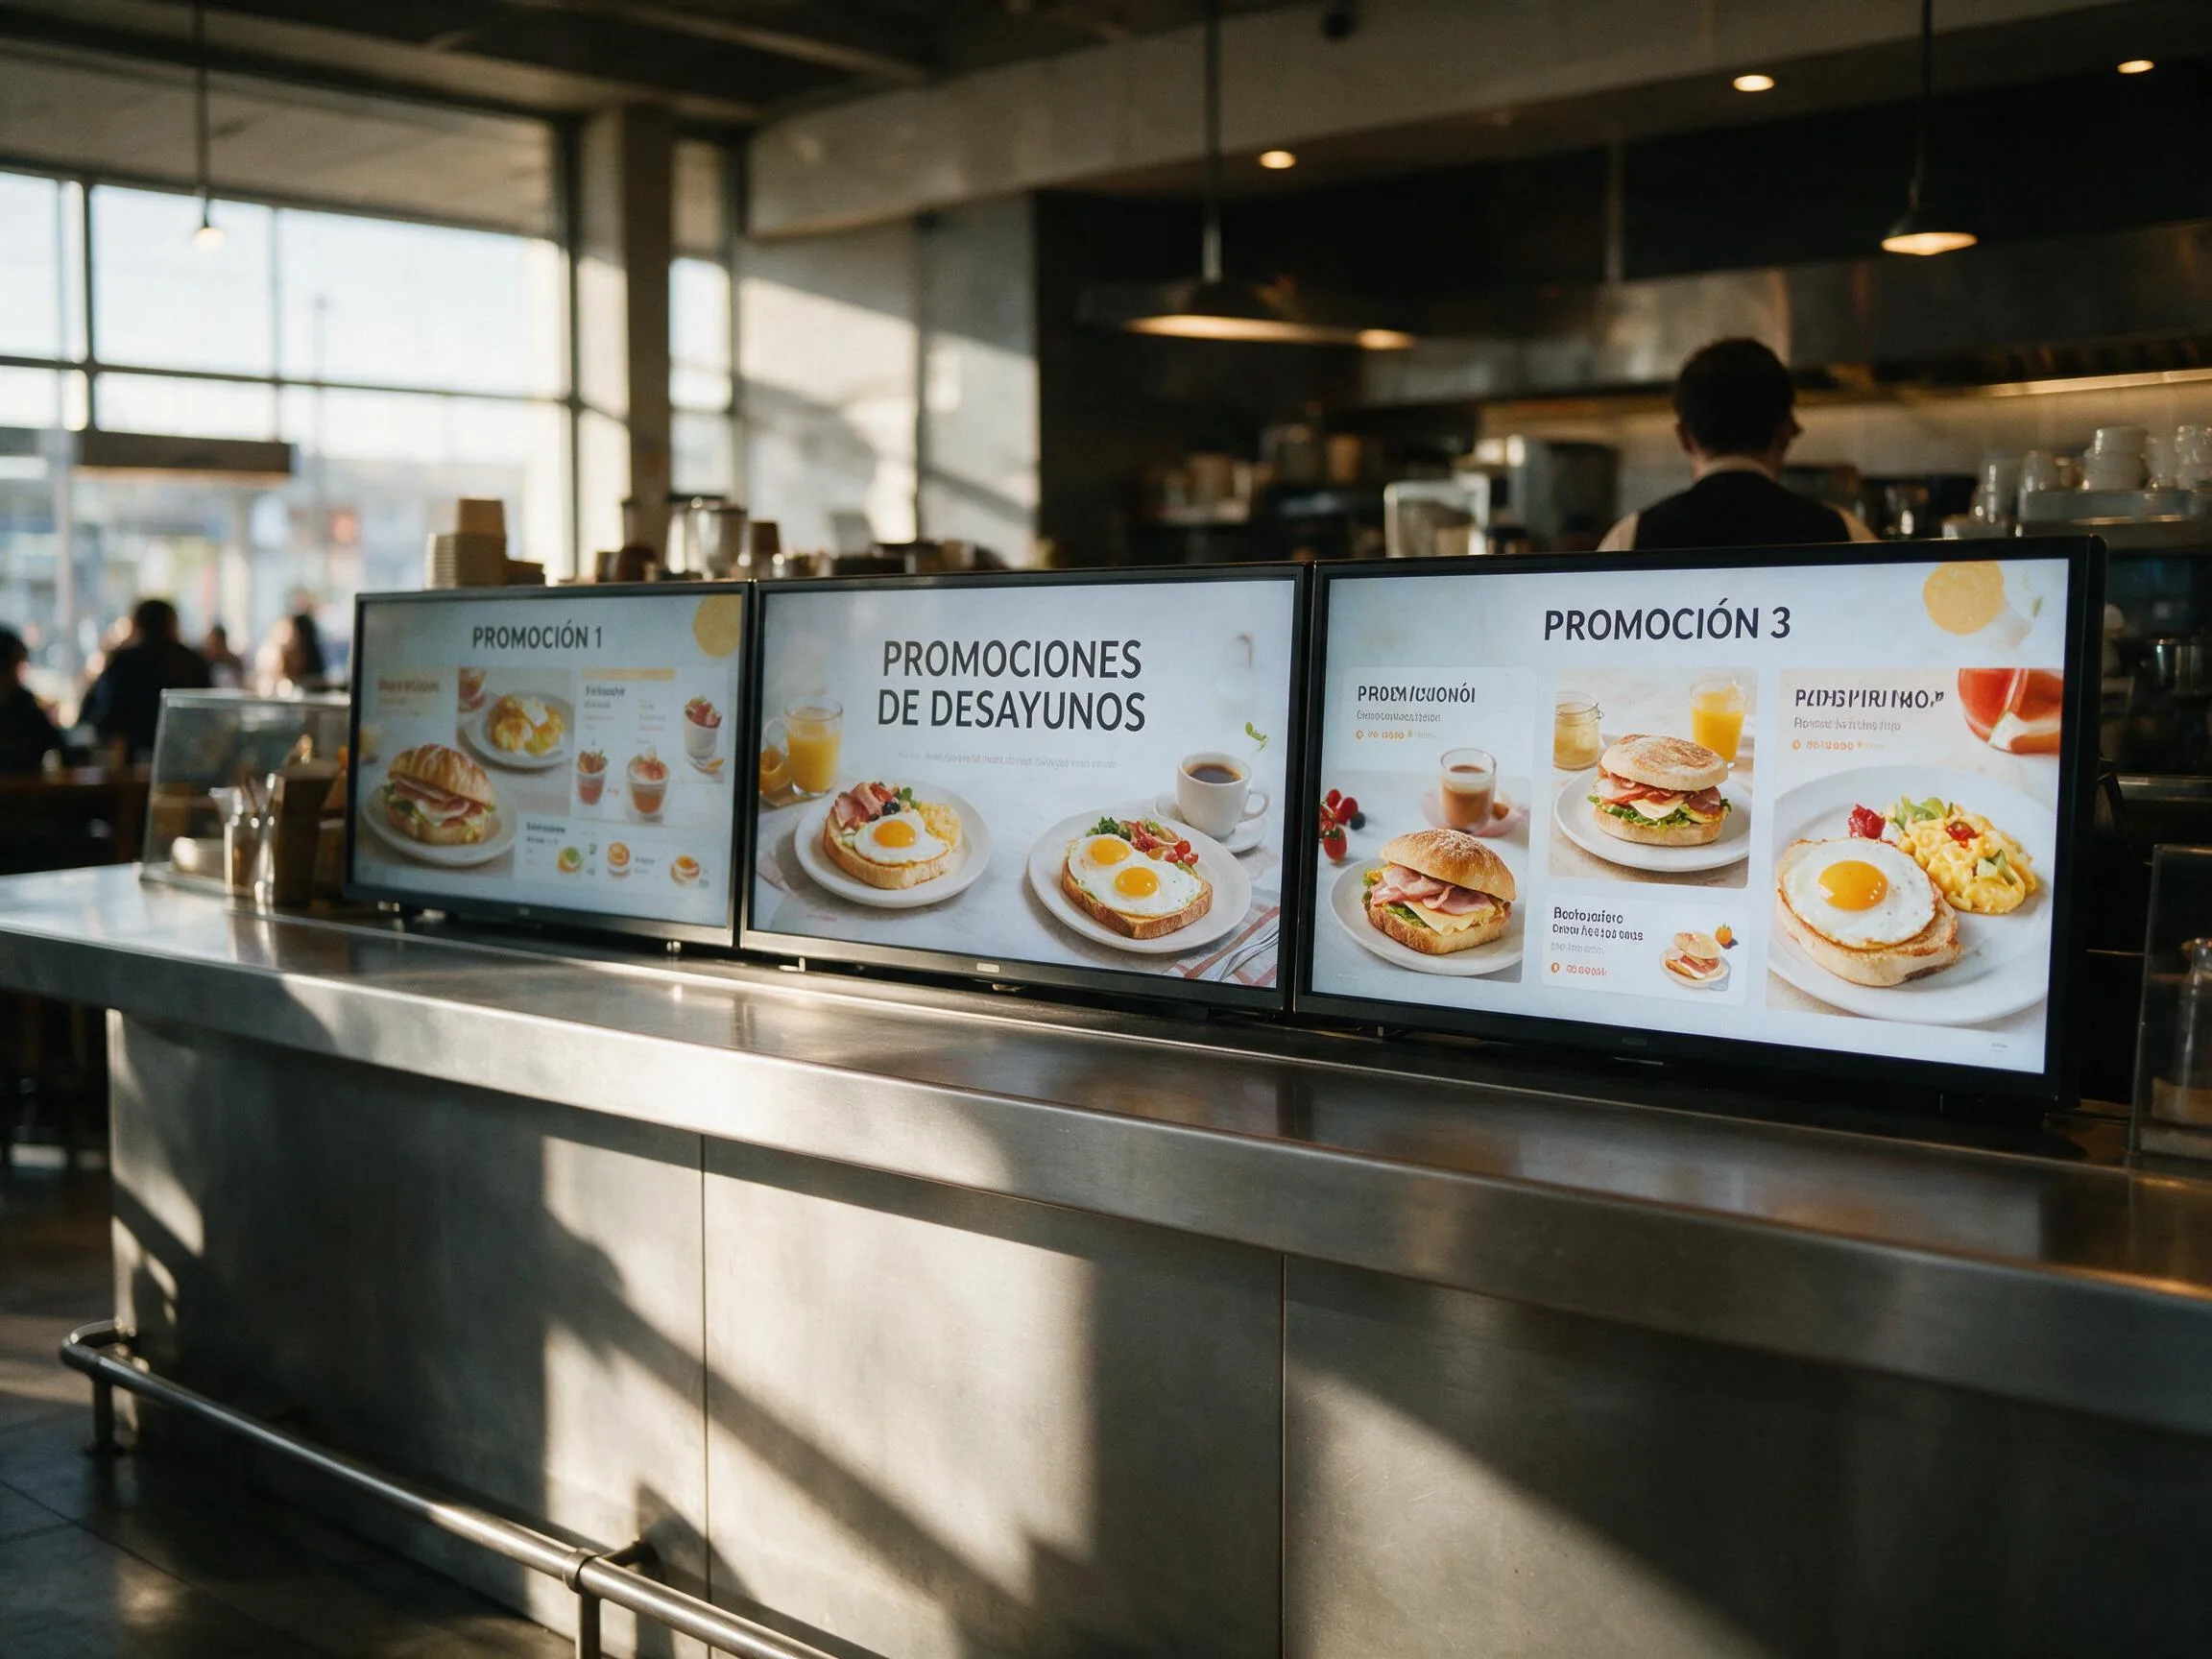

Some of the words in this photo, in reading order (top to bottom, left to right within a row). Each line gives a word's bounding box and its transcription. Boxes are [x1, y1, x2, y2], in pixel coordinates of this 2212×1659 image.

[472, 619, 589, 650] PROMOCIÓN
[595, 626, 603, 649] 1
[1544, 597, 1759, 641] PROMOCIÓN
[1770, 606, 1791, 639] 3
[883, 639, 1142, 680] PROMOCIONES
[878, 688, 921, 726] DE
[930, 689, 1146, 733] DESAYUNOS
